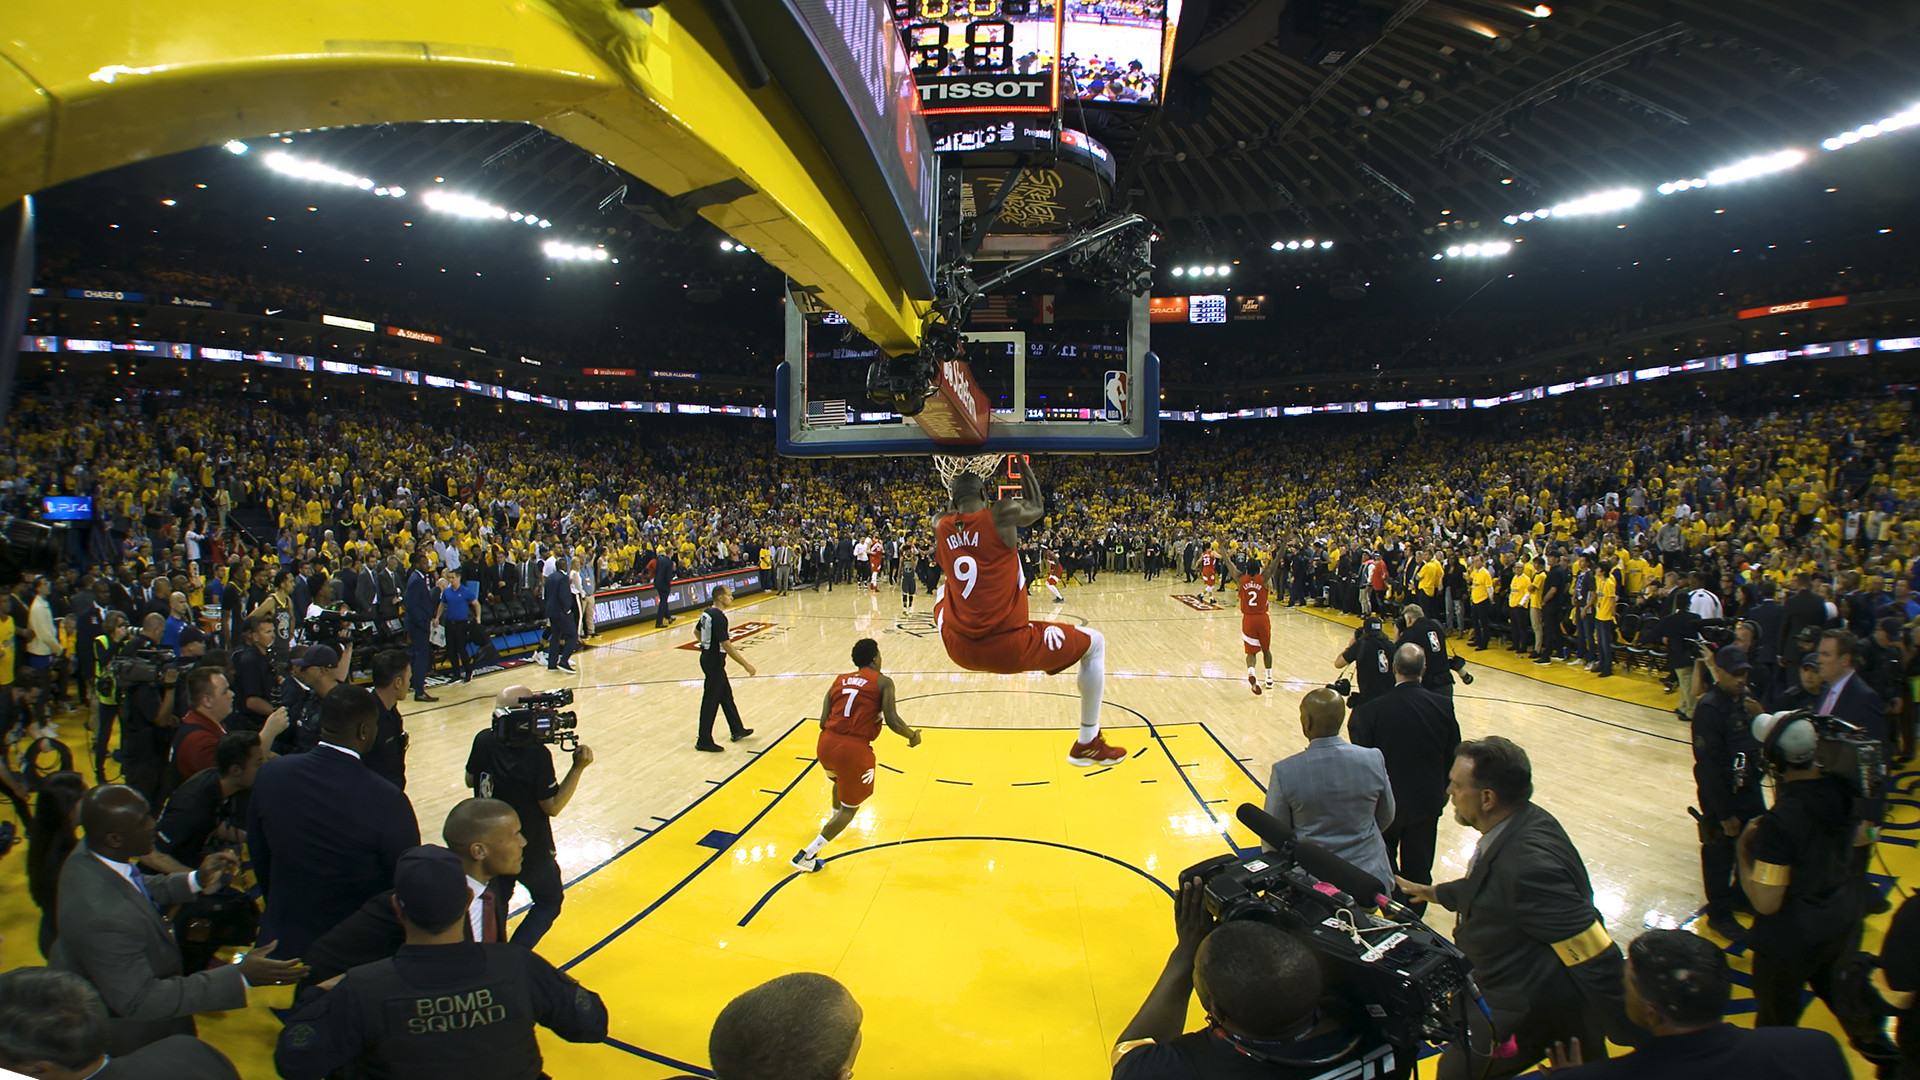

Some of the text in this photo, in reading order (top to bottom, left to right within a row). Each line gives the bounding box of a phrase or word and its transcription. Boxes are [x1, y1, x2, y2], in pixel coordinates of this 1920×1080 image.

[917, 82, 1044, 101] TISSOT
[84, 290, 115, 299] CHASE
[1768, 302, 1811, 314] ORACLE
[1107, 410, 1119, 419] NBA
[57, 503, 91, 512] PS4
[946, 531, 979, 550] IBAKA
[953, 555, 978, 600] 9
[609, 598, 632, 620] FINALS
[631, 596, 641, 615] 2019
[1248, 591, 1258, 606] 2
[842, 688, 859, 717] 7
[416, 988, 493, 1017] BOMB
[408, 1004, 506, 1034] SQUAD
